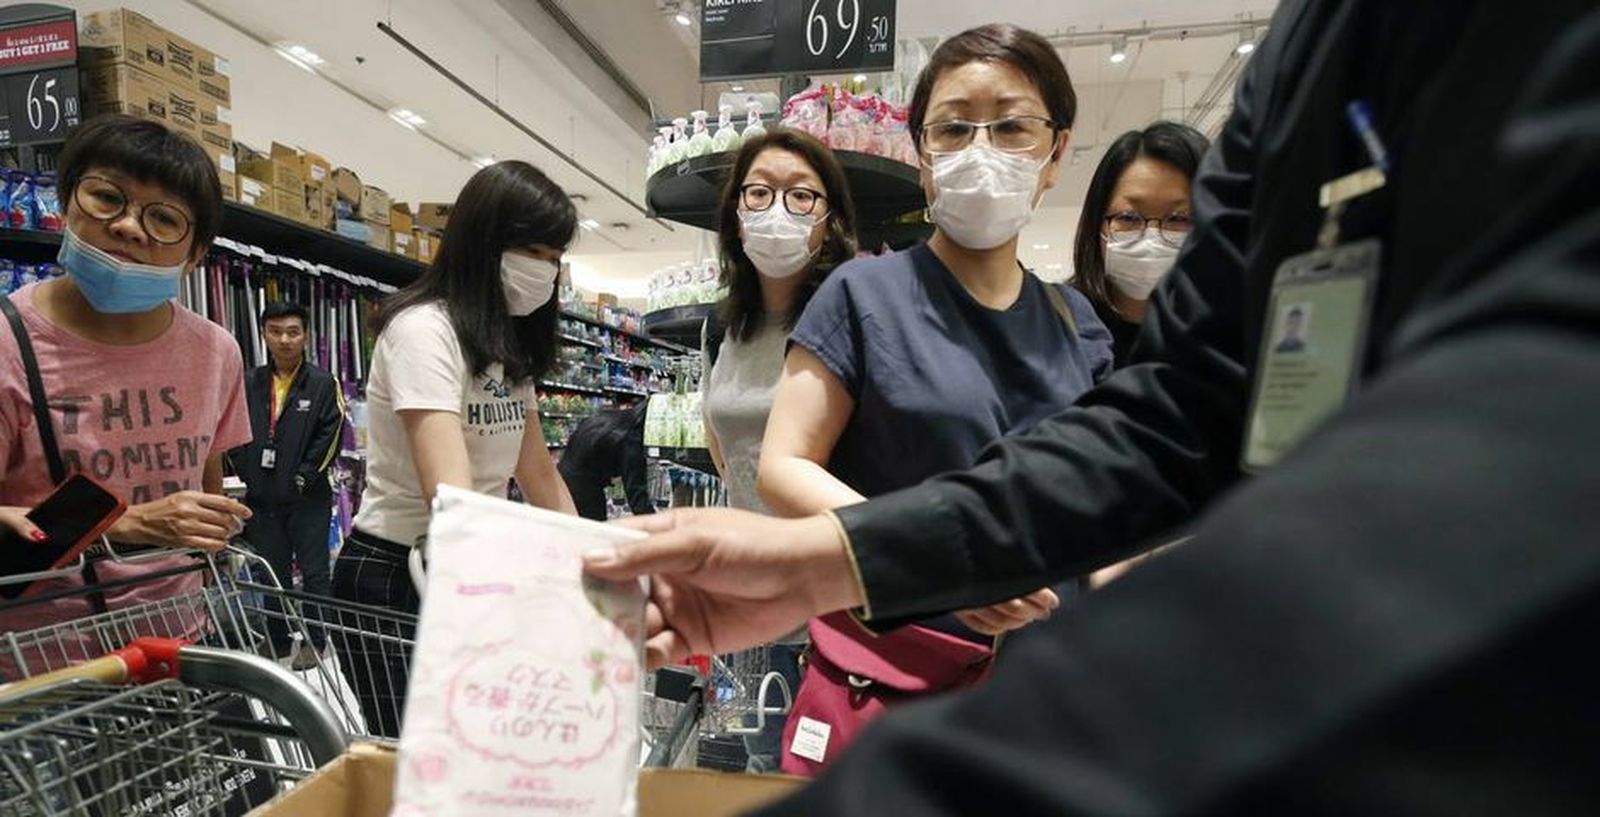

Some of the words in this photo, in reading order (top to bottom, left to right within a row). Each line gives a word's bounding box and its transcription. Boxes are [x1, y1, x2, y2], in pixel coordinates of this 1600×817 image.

[806, 0, 859, 59] 69
[27, 74, 59, 132] 65
[47, 386, 184, 434] THIS
